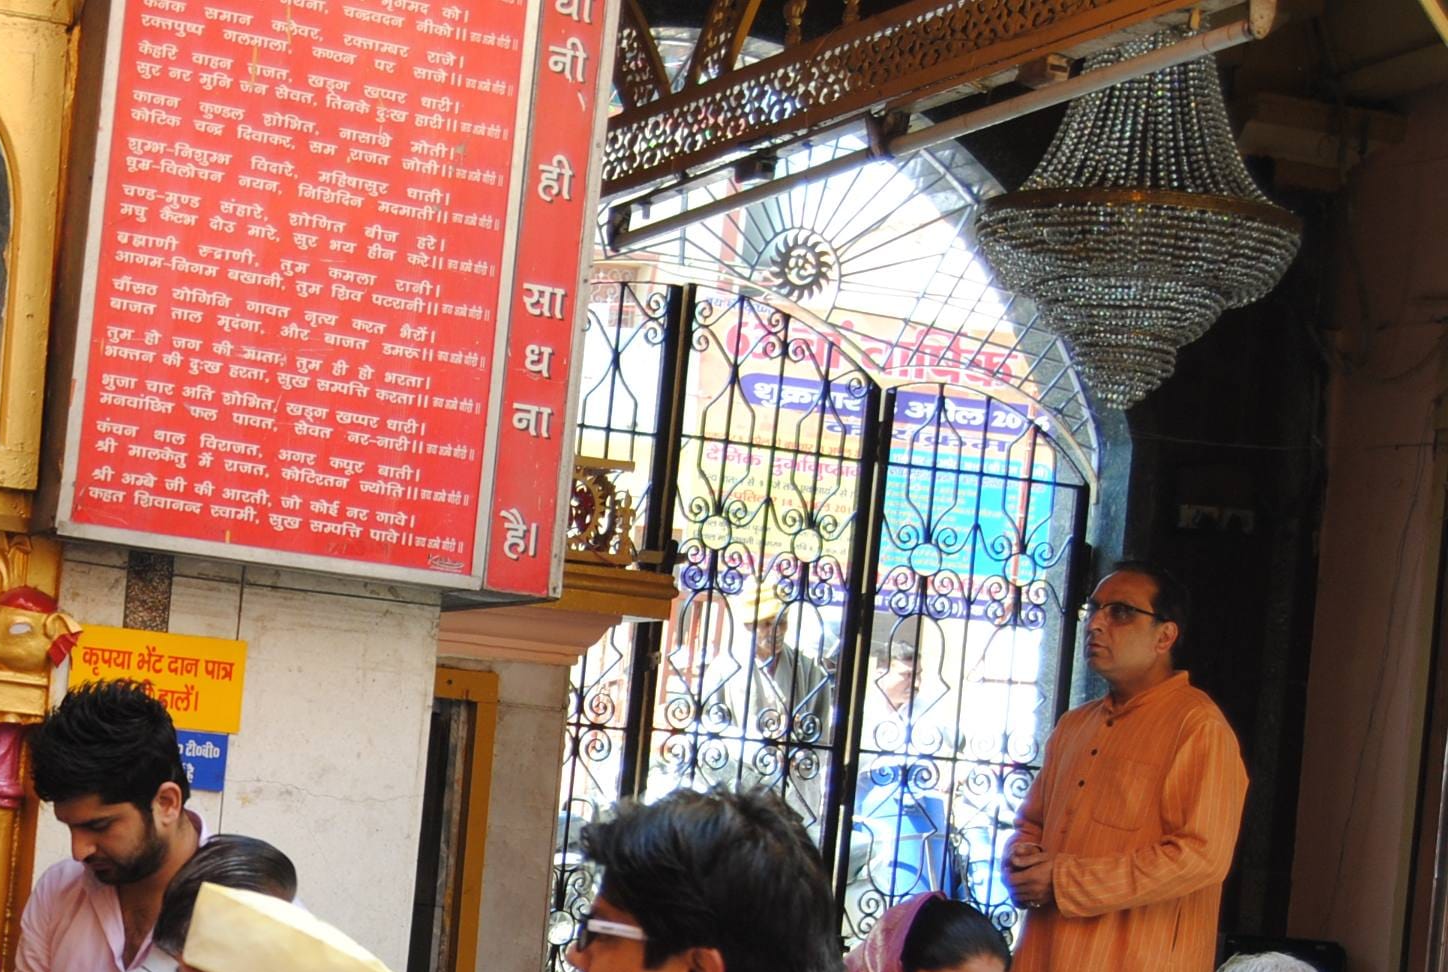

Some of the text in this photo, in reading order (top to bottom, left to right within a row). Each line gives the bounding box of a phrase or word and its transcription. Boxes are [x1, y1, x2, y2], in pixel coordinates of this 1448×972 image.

[203, 6, 254, 26] समान
[343, 33, 410, 58] रक्ताम्बर
[342, 5, 406, 28] चन्द्रवदन
[140, 13, 206, 38] रक्तपुष्प
[311, 45, 358, 65] कण्ठन
[374, 58, 397, 74] पर
[135, 60, 163, 80] सुर
[168, 66, 193, 82] नर
[198, 71, 234, 91] मुनि
[325, 88, 371, 114] तिनके
[137, 38, 179, 61] केहरि
[191, 51, 235, 70] वाहन
[363, 84, 408, 104] खप्पर
[132, 88, 182, 109] कानन
[199, 101, 246, 121] कुण्डल
[130, 106, 182, 127] कोटिक
[192, 119, 226, 136] चन्द्र
[308, 139, 339, 156] सम
[297, 181, 366, 208] निशिदिन
[317, 169, 390, 198] महिषासुर
[208, 214, 237, 234] दोउ
[292, 231, 319, 251] सुर
[329, 238, 358, 254] भय
[366, 241, 397, 262] हीन
[287, 211, 348, 234] शोणित
[363, 223, 400, 243] बीज
[279, 258, 311, 277] तुम
[327, 264, 378, 286] कमला
[295, 279, 324, 298] तुम
[330, 282, 365, 302] शिव
[109, 295, 158, 315] बाजत
[170, 306, 204, 324] ताल
[279, 321, 311, 341] और
[323, 332, 370, 351] बाजत
[171, 285, 388, 335] योगिनि गावत नृत्य करत
[104, 340, 157, 363] भक्तन
[161, 350, 185, 368] की
[276, 371, 312, 391] सुख
[316, 377, 371, 398] सम्पत्ति
[105, 325, 135, 341] तुम
[142, 328, 163, 345] हो
[171, 335, 204, 352] जग
[211, 339, 235, 357] की
[295, 356, 324, 375] तुम
[331, 358, 350, 377] ही
[357, 363, 376, 381] हो
[101, 372, 139, 392] भुजा
[144, 379, 176, 396] चार
[181, 383, 216, 401] अति
[335, 409, 381, 429] खप्पर
[94, 436, 119, 454] श्री
[197, 451, 215, 468] में
[96, 417, 140, 437] कंचन
[277, 448, 318, 466] अगर
[292, 419, 335, 439] सेवत
[88, 486, 127, 503] कहत
[133, 489, 204, 515] शिवानन्द
[268, 512, 304, 532] सुख
[309, 519, 364, 539] सम्पत्ति
[91, 465, 115, 482] श्री
[120, 471, 158, 489] अम्बे
[163, 475, 188, 493] जी
[193, 479, 216, 497] की
[280, 493, 304, 510] जो
[309, 498, 341, 518] कोई
[345, 506, 371, 521] नर
[82, 645, 236, 682] कृपया भेंट दान पात्र
